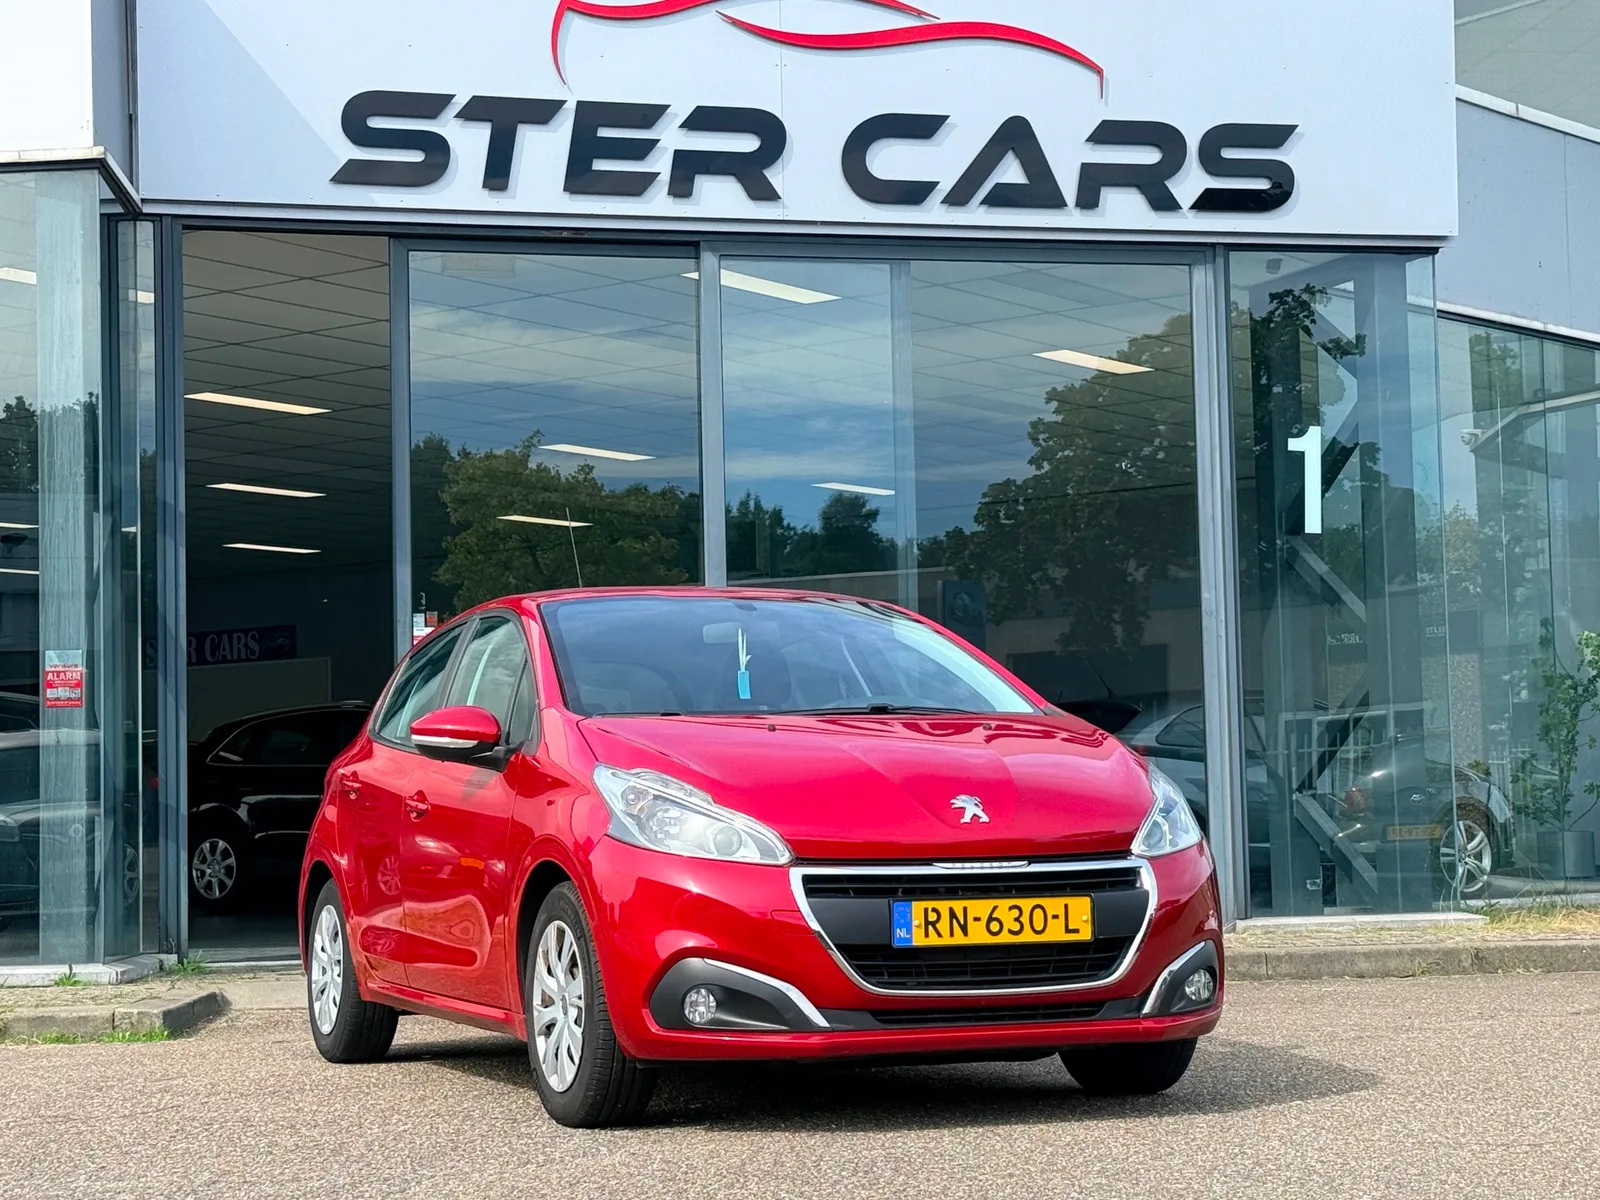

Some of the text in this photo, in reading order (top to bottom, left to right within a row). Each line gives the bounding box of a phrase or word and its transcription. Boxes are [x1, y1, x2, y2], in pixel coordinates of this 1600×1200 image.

[329, 90, 1299, 212] STER CARS
[1288, 426, 1322, 534] 1
[204, 631, 260, 662] CARS
[47, 671, 81, 681] ALARM
[896, 928, 911, 938] NL
[923, 903, 1080, 938] RN-630-L
